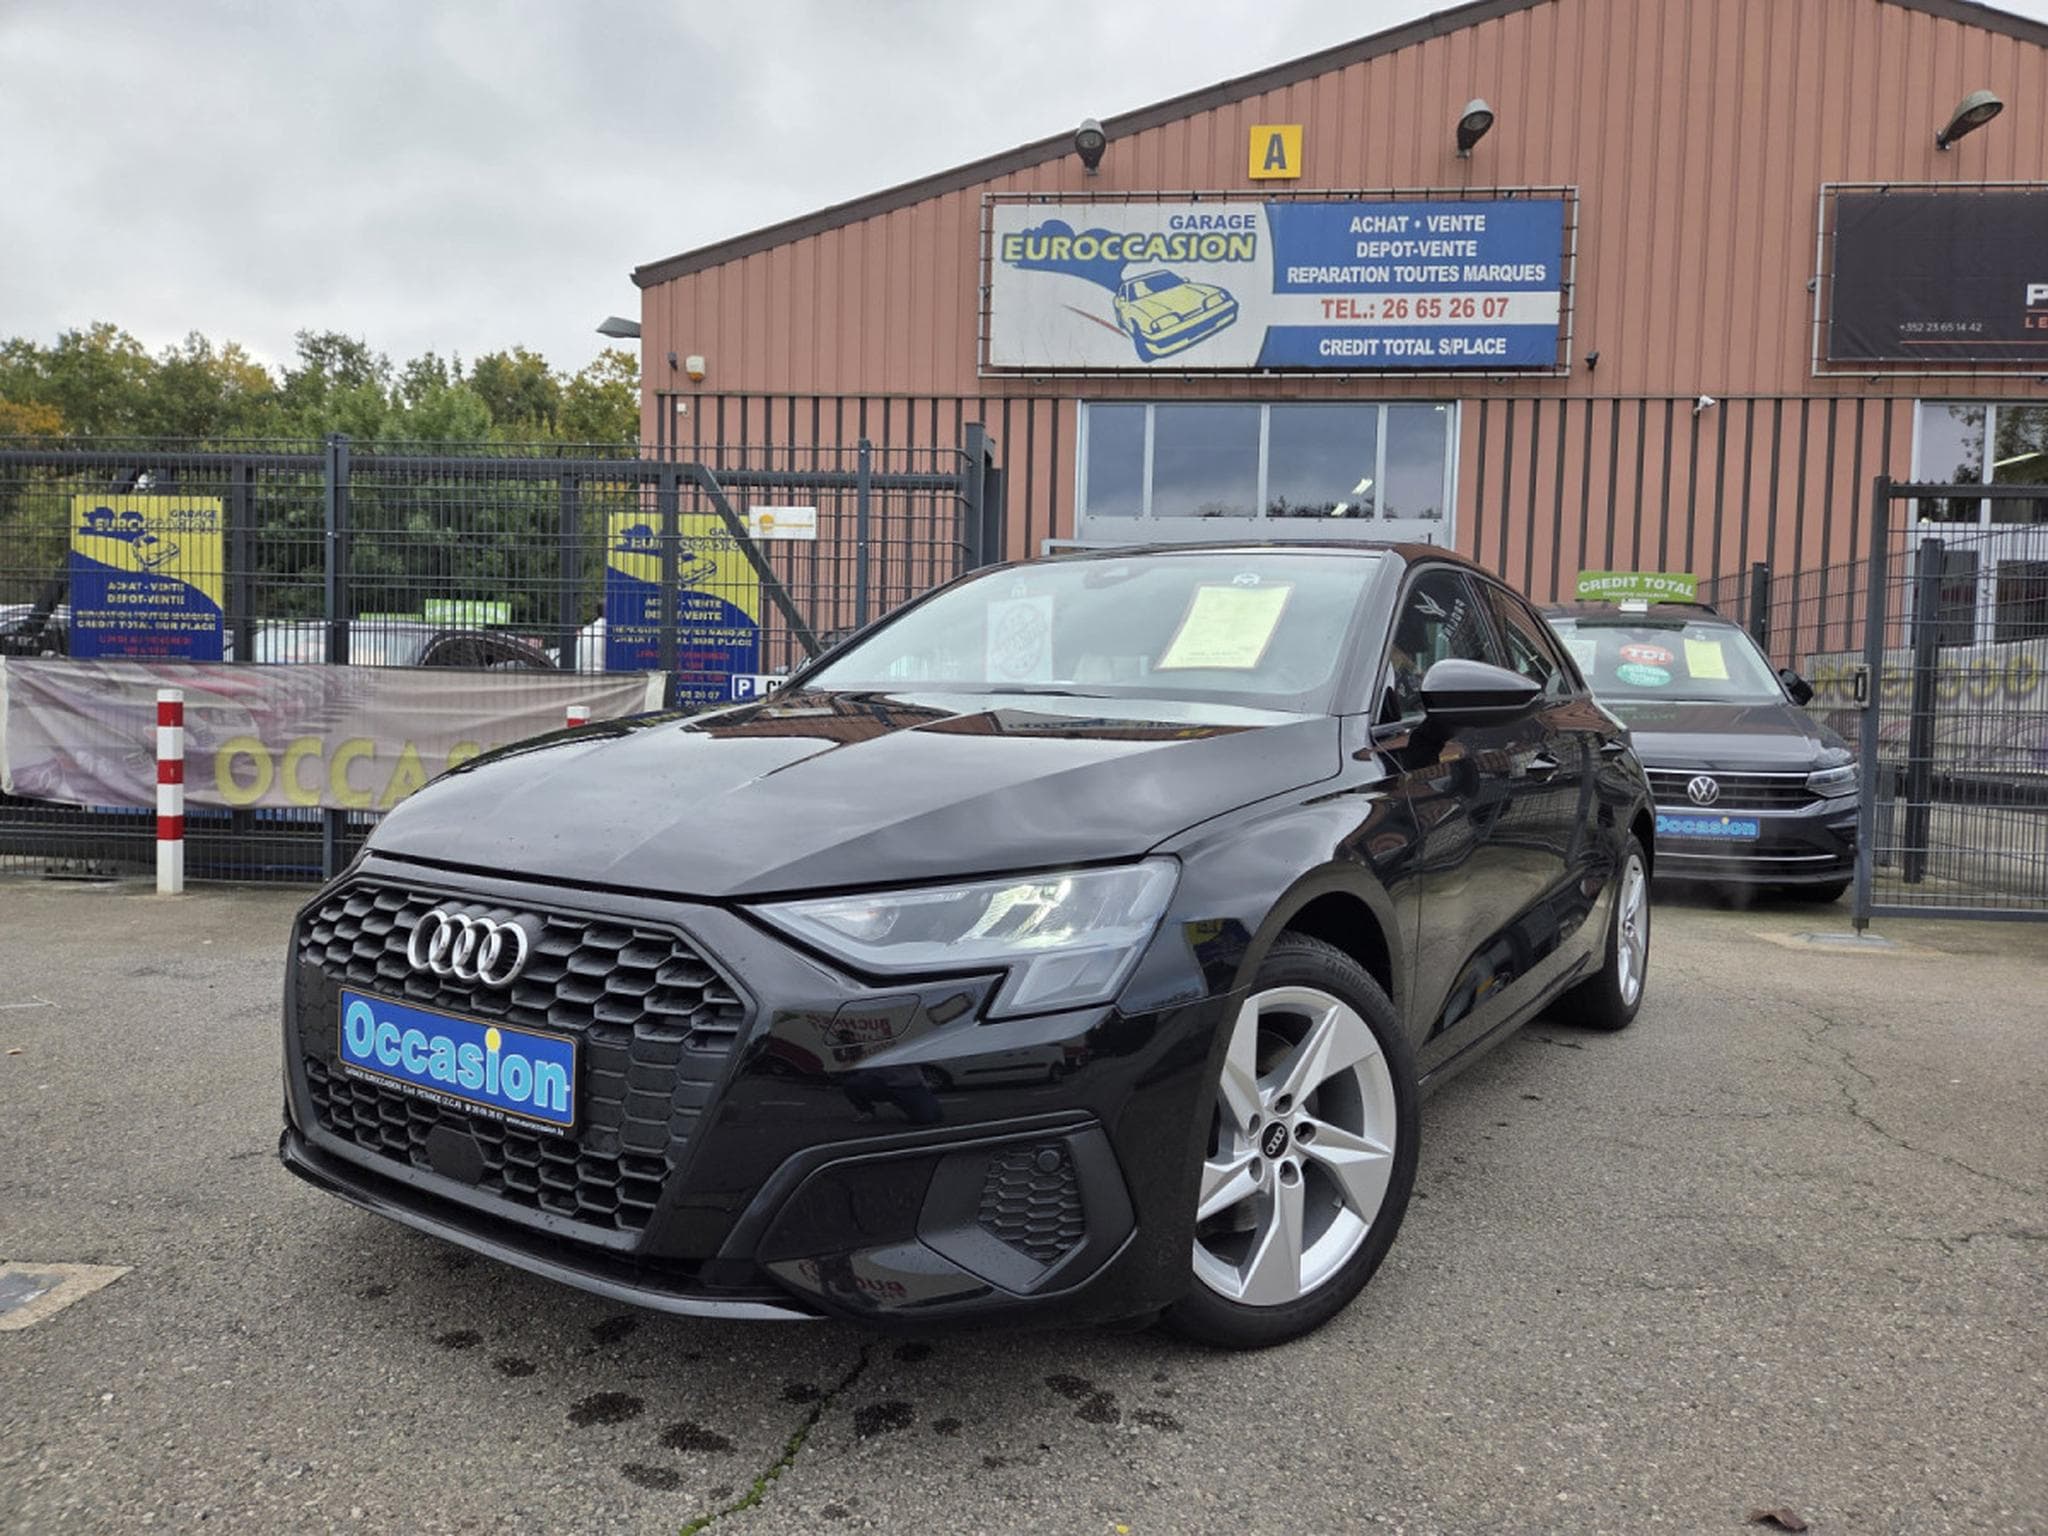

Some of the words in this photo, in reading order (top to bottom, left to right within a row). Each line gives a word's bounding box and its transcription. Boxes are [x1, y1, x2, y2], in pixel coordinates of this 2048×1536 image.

[1264, 134, 1287, 170] A
[1169, 215, 1256, 229] GARAGE
[1350, 216, 1409, 233] ACHAT
[1427, 214, 1486, 232] VENTE
[1001, 232, 1258, 263] EUROCCASION
[1356, 240, 1478, 258] DEPOT-VENTE
[1287, 266, 1390, 284] REPARATION
[1394, 265, 1460, 282] TOUTES
[1463, 264, 1547, 282] MARQUES
[1321, 299, 1375, 319] TEL.:
[1382, 299, 1408, 319] 26
[1415, 298, 1441, 318] 65
[1449, 298, 1475, 318] 26
[1482, 297, 1509, 318] 07
[1319, 338, 1379, 356] CREDIT
[1382, 338, 1434, 356] TOTAL
[1439, 337, 1507, 355] S/PLACE
[1579, 576, 1638, 592] CREDIT
[1645, 578, 1693, 596] TOTAL
[345, 1000, 569, 1112] Occasion
